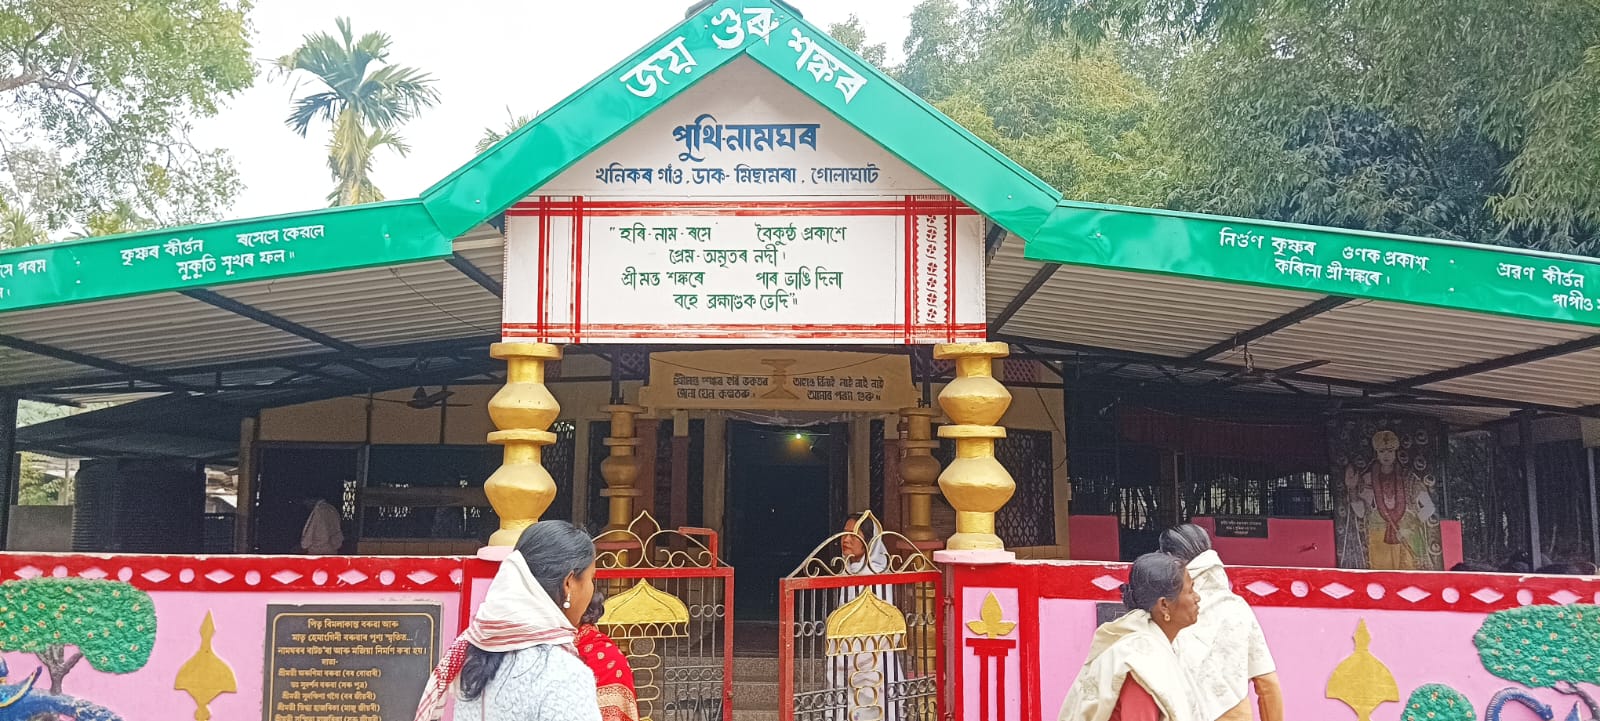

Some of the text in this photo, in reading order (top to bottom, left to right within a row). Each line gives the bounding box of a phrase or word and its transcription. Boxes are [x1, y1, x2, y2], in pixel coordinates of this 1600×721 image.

[619, 36, 697, 98] জয়
[787, 27, 868, 104] শঙ্কৰ
[595, 161, 653, 185] খনিকৰ
[811, 162, 880, 184] গোলাঘাট
[686, 226, 711, 243] ৰসে
[801, 226, 847, 244] প্ৰকাশে
[1219, 226, 1265, 249] নিৰ্গুণ
[1271, 236, 1317, 257] কৃষ্ণৰ
[1342, 246, 1381, 264] গুণক
[17, 258, 47, 275] পৰম
[120, 245, 160, 266] কৃষ্ণৰ
[176, 253, 217, 281] মুকুতি
[702, 249, 748, 269] অমৃতৰ
[666, 271, 706, 288] শঙ্কৰে
[755, 271, 779, 290] পাৰ
[814, 265, 844, 290] দিলা
[1274, 256, 1323, 279] কৰিলা
[672, 294, 699, 310] বহে
